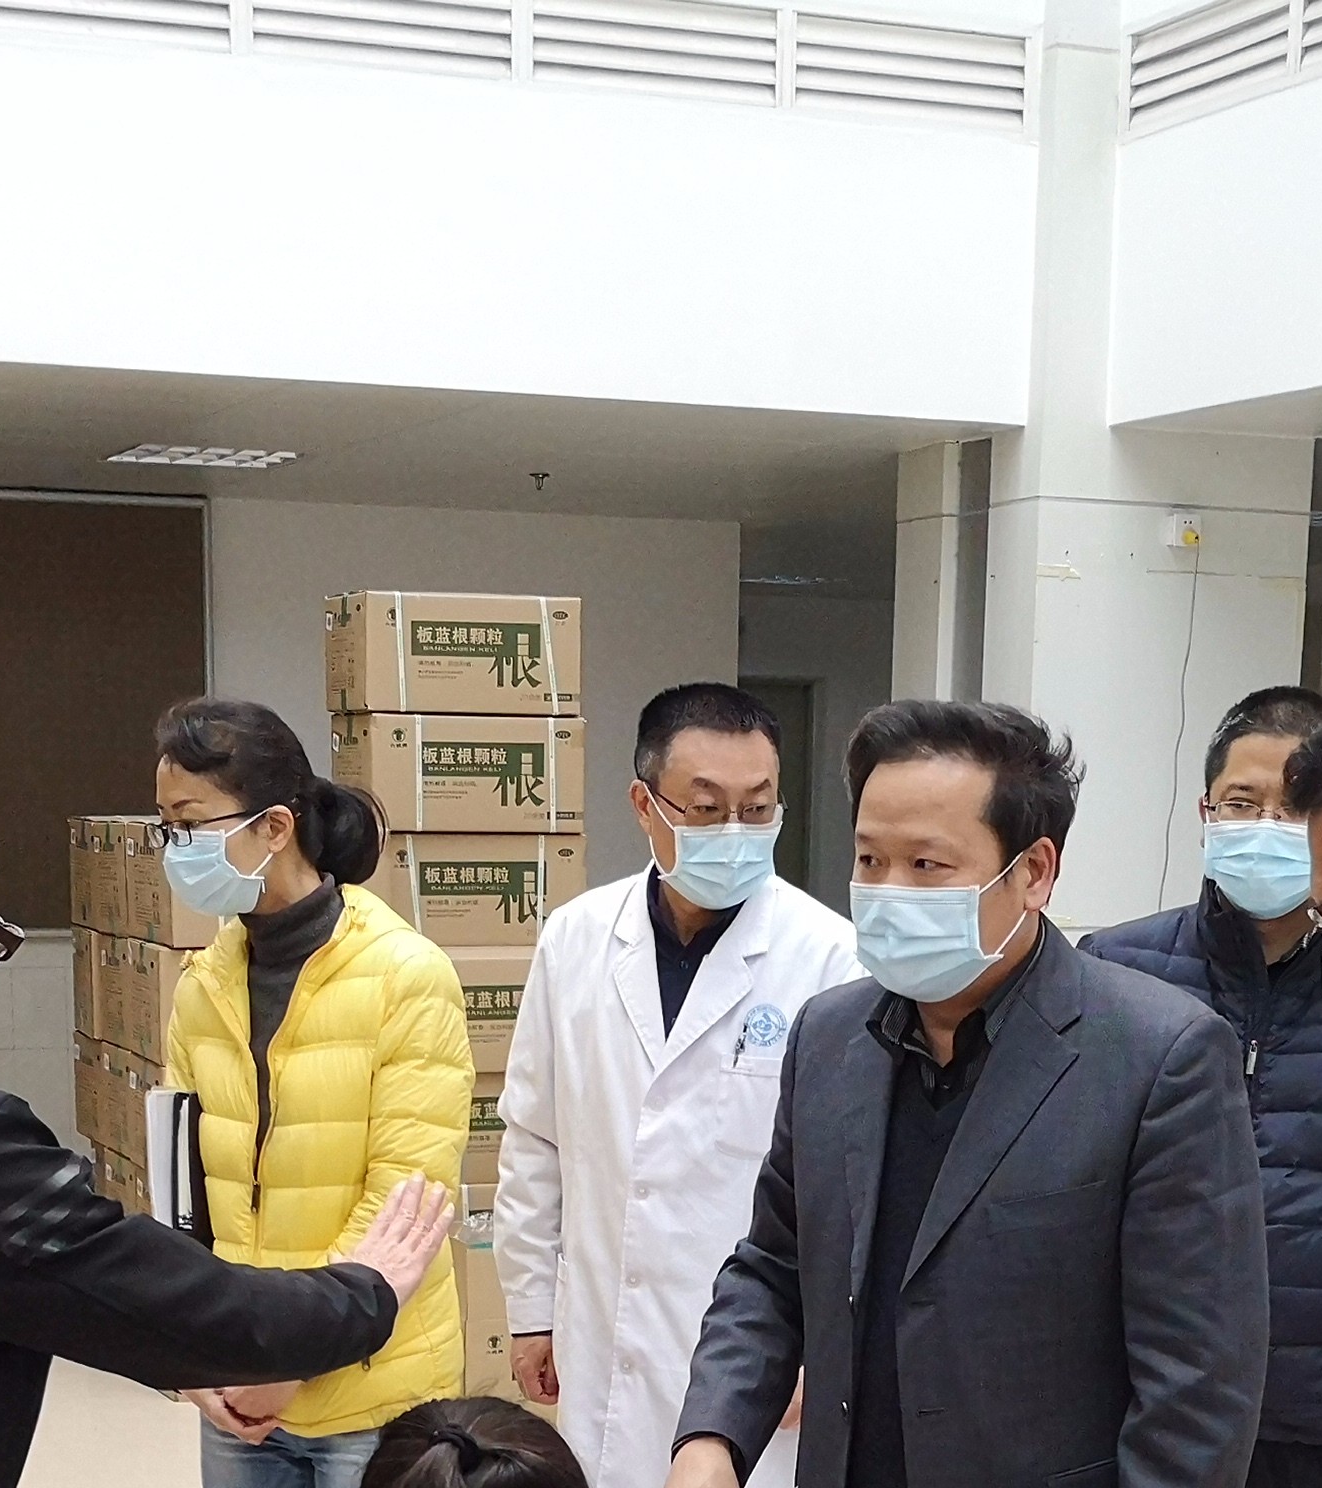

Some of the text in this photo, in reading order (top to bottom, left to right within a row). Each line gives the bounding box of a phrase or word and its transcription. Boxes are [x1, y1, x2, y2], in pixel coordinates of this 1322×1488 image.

[417, 626, 503, 645] 板蓝根颗粒
[423, 747, 507, 765] 板蓝根颗粒
[425, 867, 510, 884] 板蓝根颗粒
